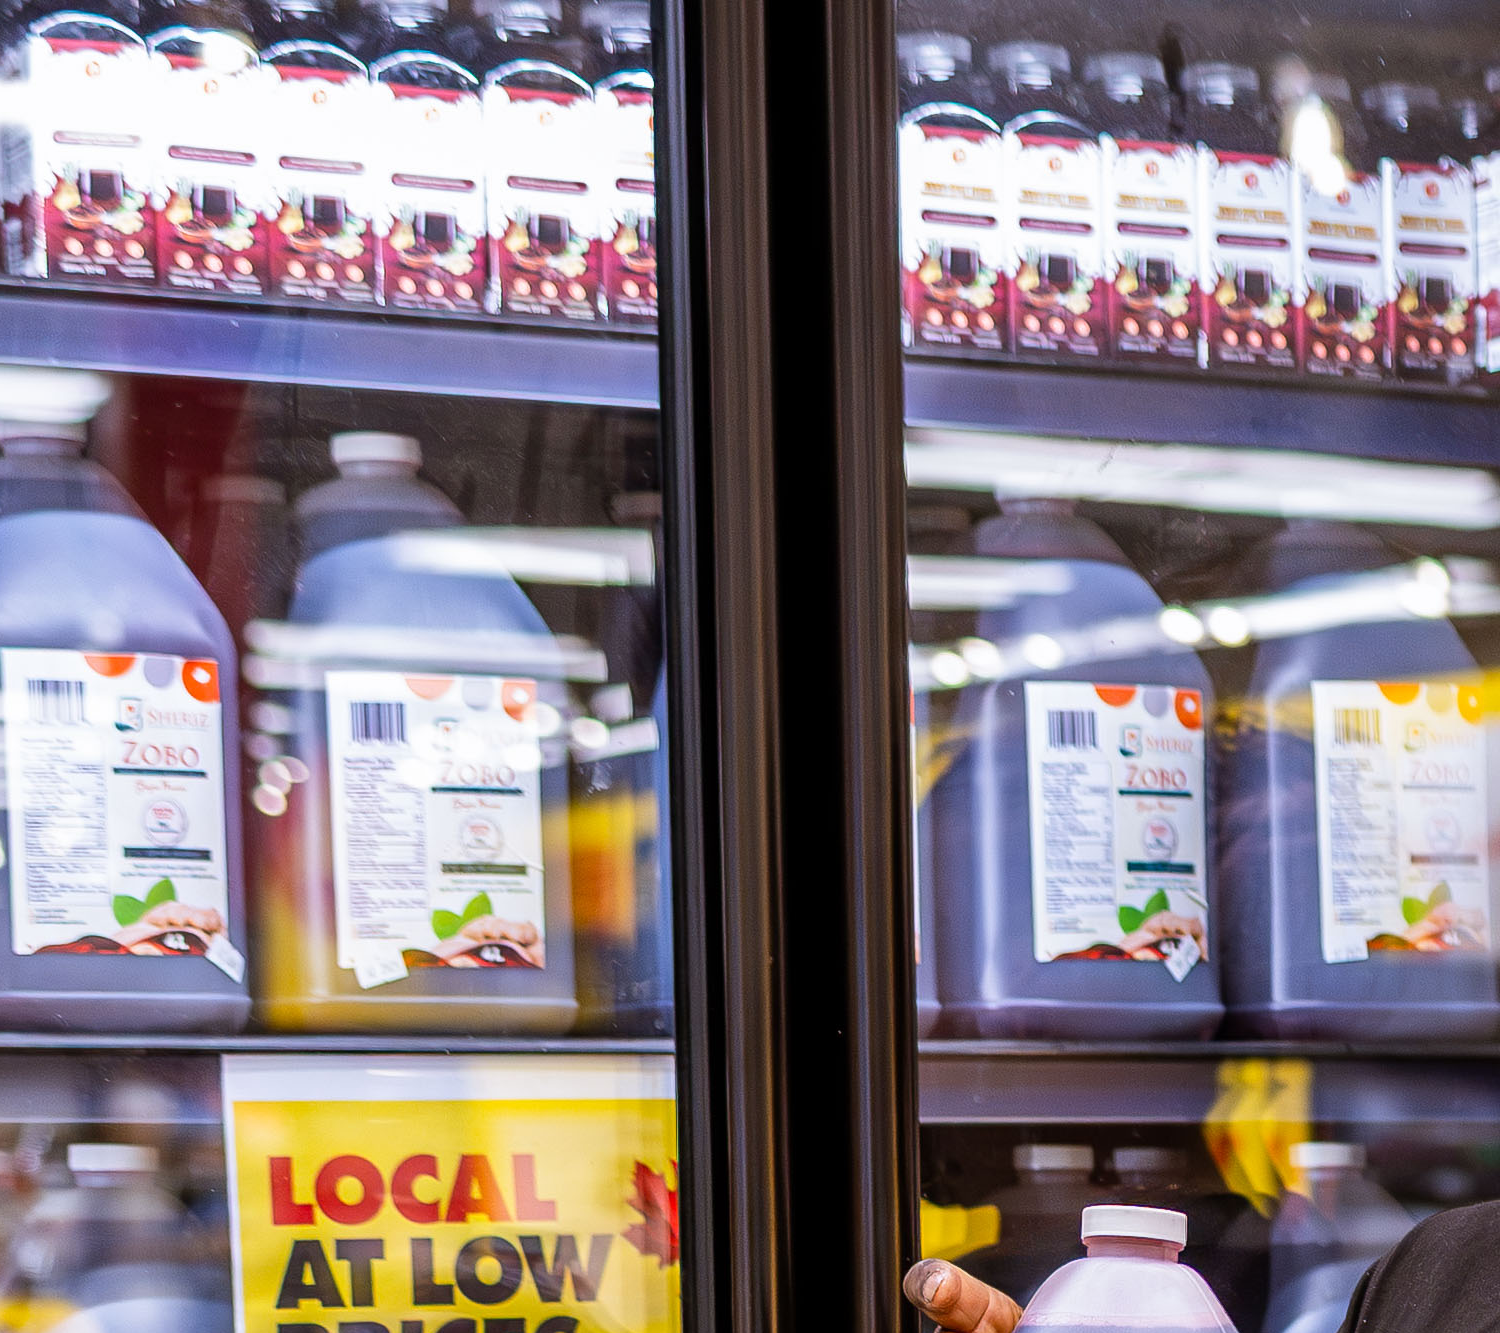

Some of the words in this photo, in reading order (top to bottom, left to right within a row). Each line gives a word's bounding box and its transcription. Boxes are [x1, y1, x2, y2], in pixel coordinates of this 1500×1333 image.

[122, 741, 199, 768] ZOBO
[440, 761, 515, 787] ZOBO
[1125, 764, 1188, 791] ZOBO
[269, 1154, 557, 1226] LOCAL
[276, 1238, 385, 1309] AT
[410, 1234, 613, 1306] LOW
